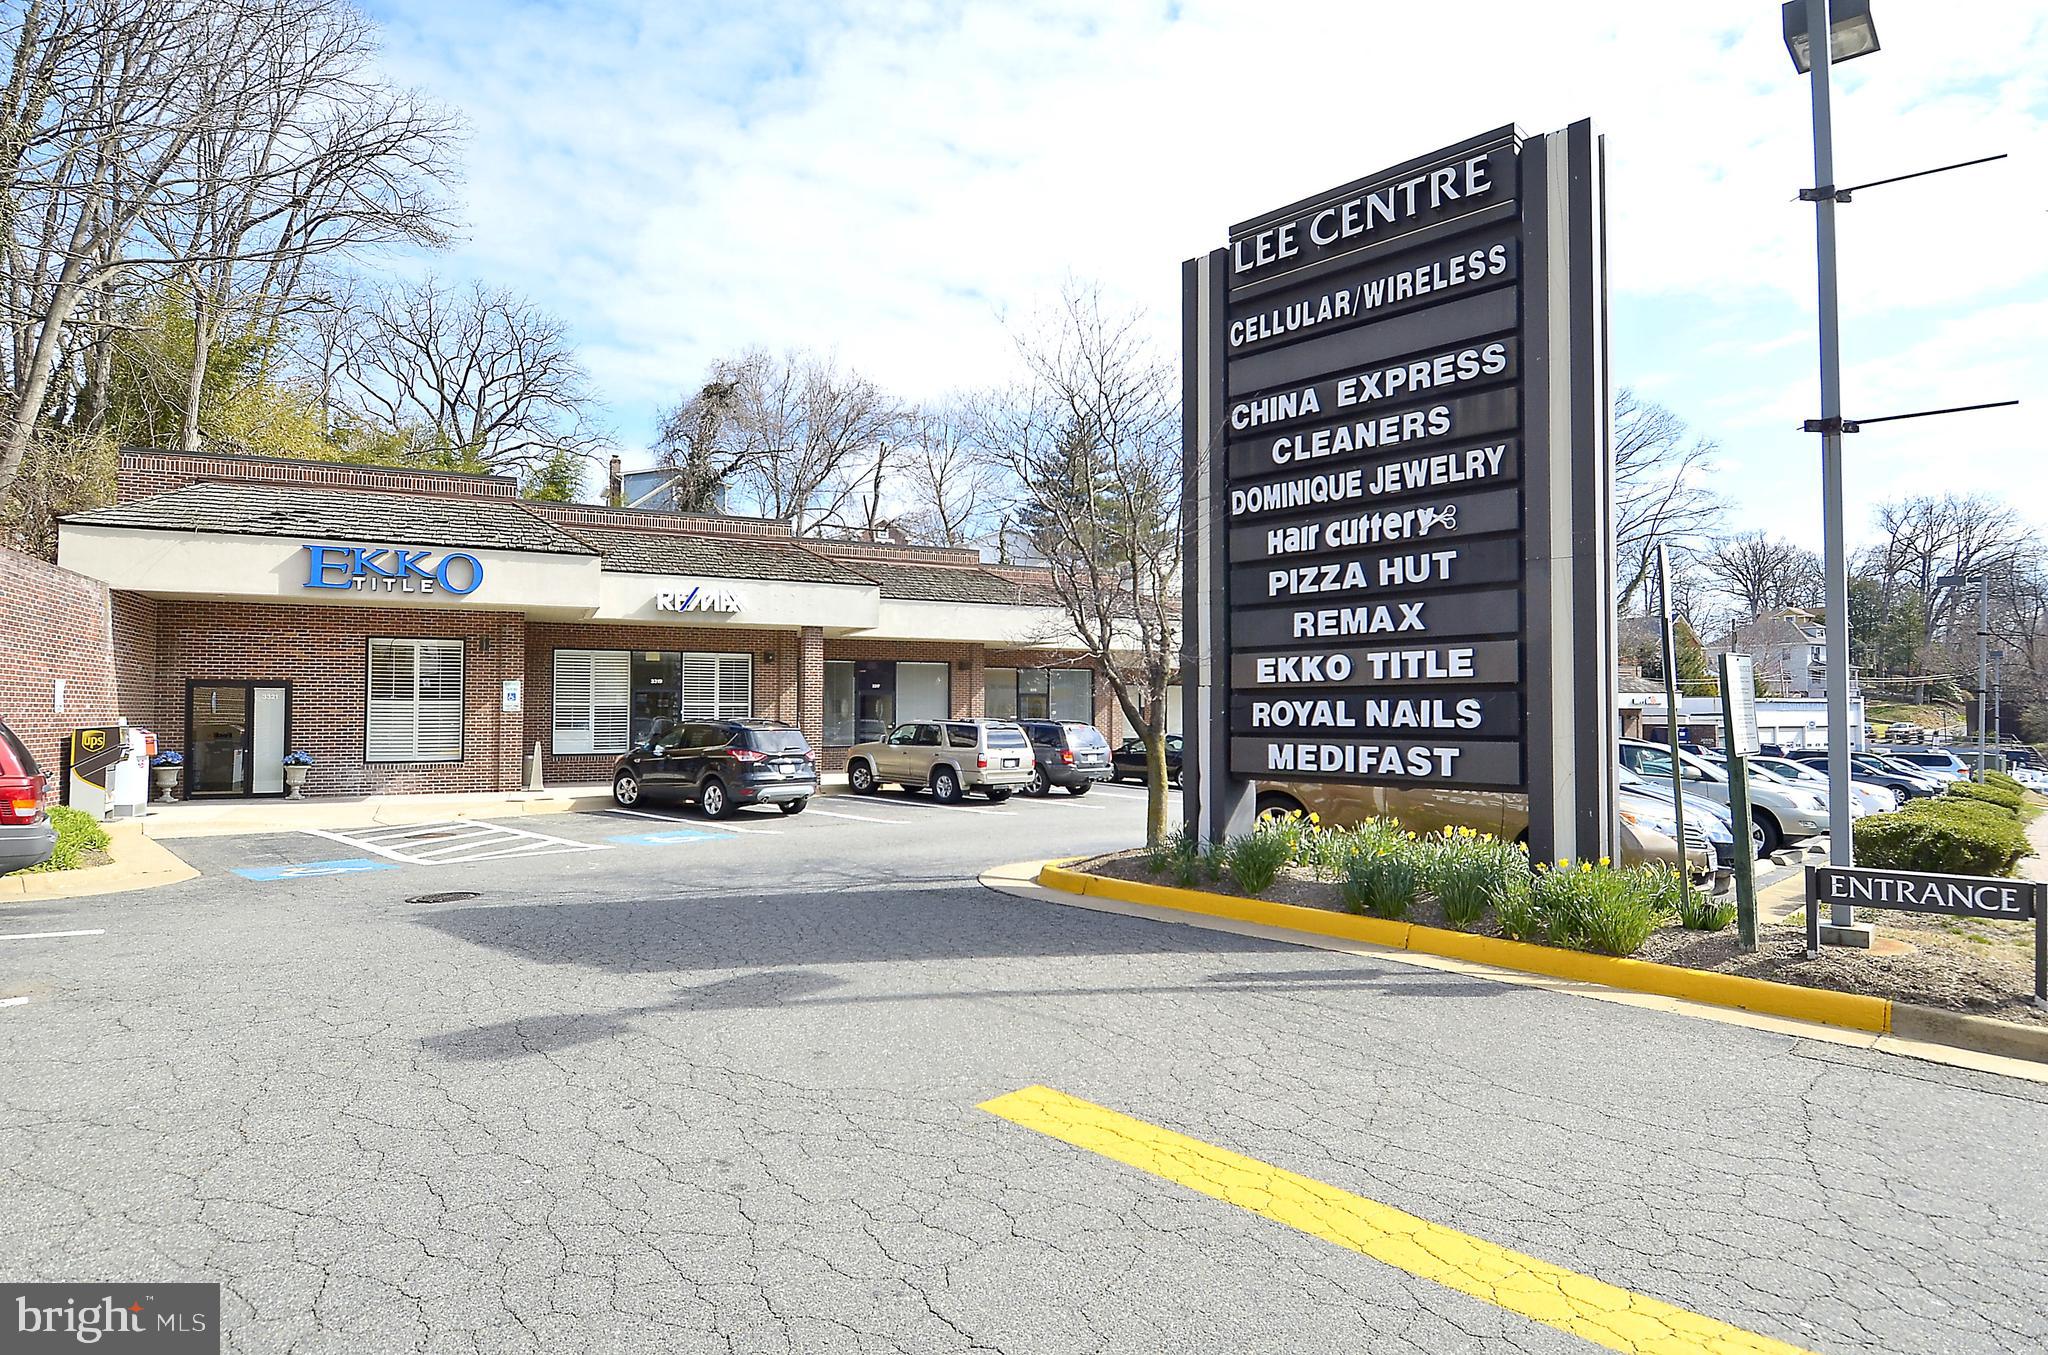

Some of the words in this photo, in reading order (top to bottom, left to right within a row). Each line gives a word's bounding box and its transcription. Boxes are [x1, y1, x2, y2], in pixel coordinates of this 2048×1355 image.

[1234, 223, 1299, 274] LEE
[1310, 153, 1492, 247] CENTRE
[1230, 244, 1506, 348] CELLULAR/WIRELESS
[1231, 388, 1320, 430] CHINA
[1337, 343, 1506, 408] EXPRESS
[1272, 406, 1451, 465] CLEANERS
[1231, 470, 1362, 516] DOMINIQUE
[1369, 445, 1506, 496] JEWELRY
[1267, 525, 1320, 555] Hair
[1325, 507, 1434, 548] cuttery
[302, 545, 484, 595] EKKO
[352, 576, 434, 594] TITLE
[1268, 561, 1367, 597] PIZZA
[1379, 550, 1457, 586] HUT
[1293, 602, 1426, 638] REMAX
[1256, 653, 1352, 684] EKKO
[1367, 648, 1475, 680] TITLE
[1252, 700, 1356, 728] ROYAL
[1366, 698, 1482, 729] NAILS
[84, 736, 104, 749] ups
[1268, 743, 1460, 777] MEDIFAST
[1830, 875, 2021, 912] ENTRANCE
